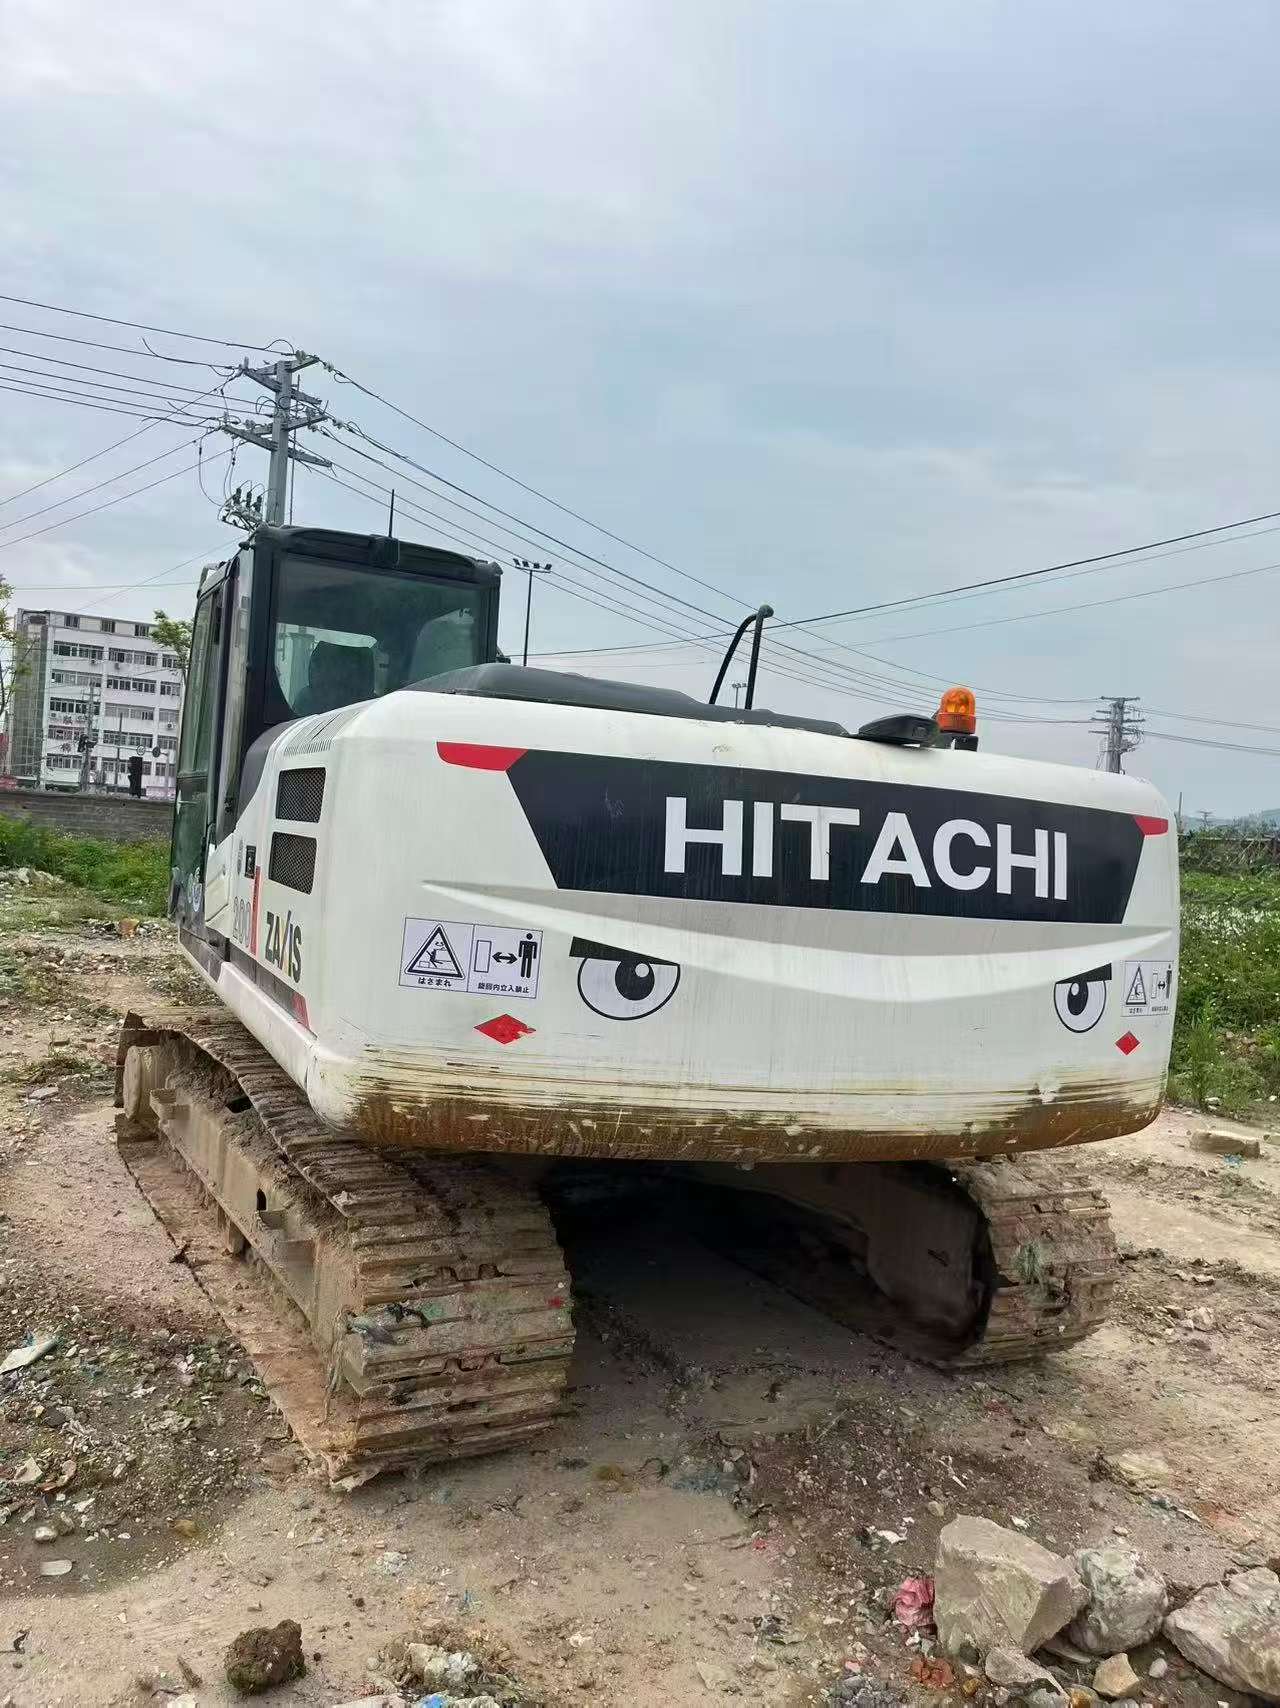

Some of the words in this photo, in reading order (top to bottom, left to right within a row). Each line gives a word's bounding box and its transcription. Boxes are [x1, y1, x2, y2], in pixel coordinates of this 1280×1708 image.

[664, 796, 1067, 900] HITACHI
[417, 976, 452, 988] はさまれ
